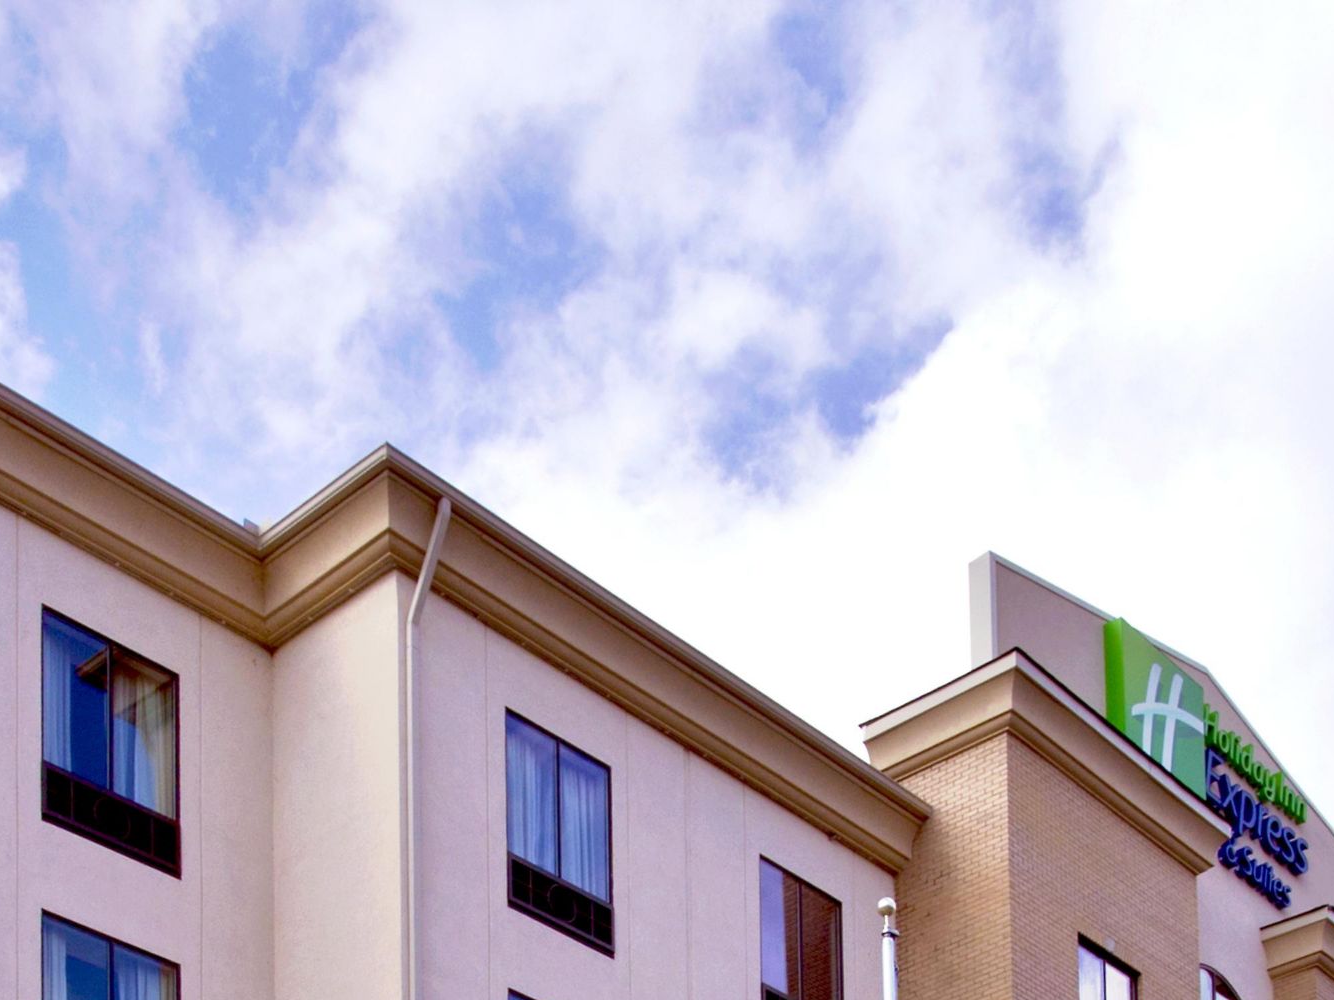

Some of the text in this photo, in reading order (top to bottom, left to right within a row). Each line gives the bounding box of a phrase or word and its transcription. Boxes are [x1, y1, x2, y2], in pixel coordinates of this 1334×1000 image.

[1203, 703, 1307, 825] Holiday Inn
[1204, 747, 1309, 876] Express
[1235, 845, 1292, 911] Suites
